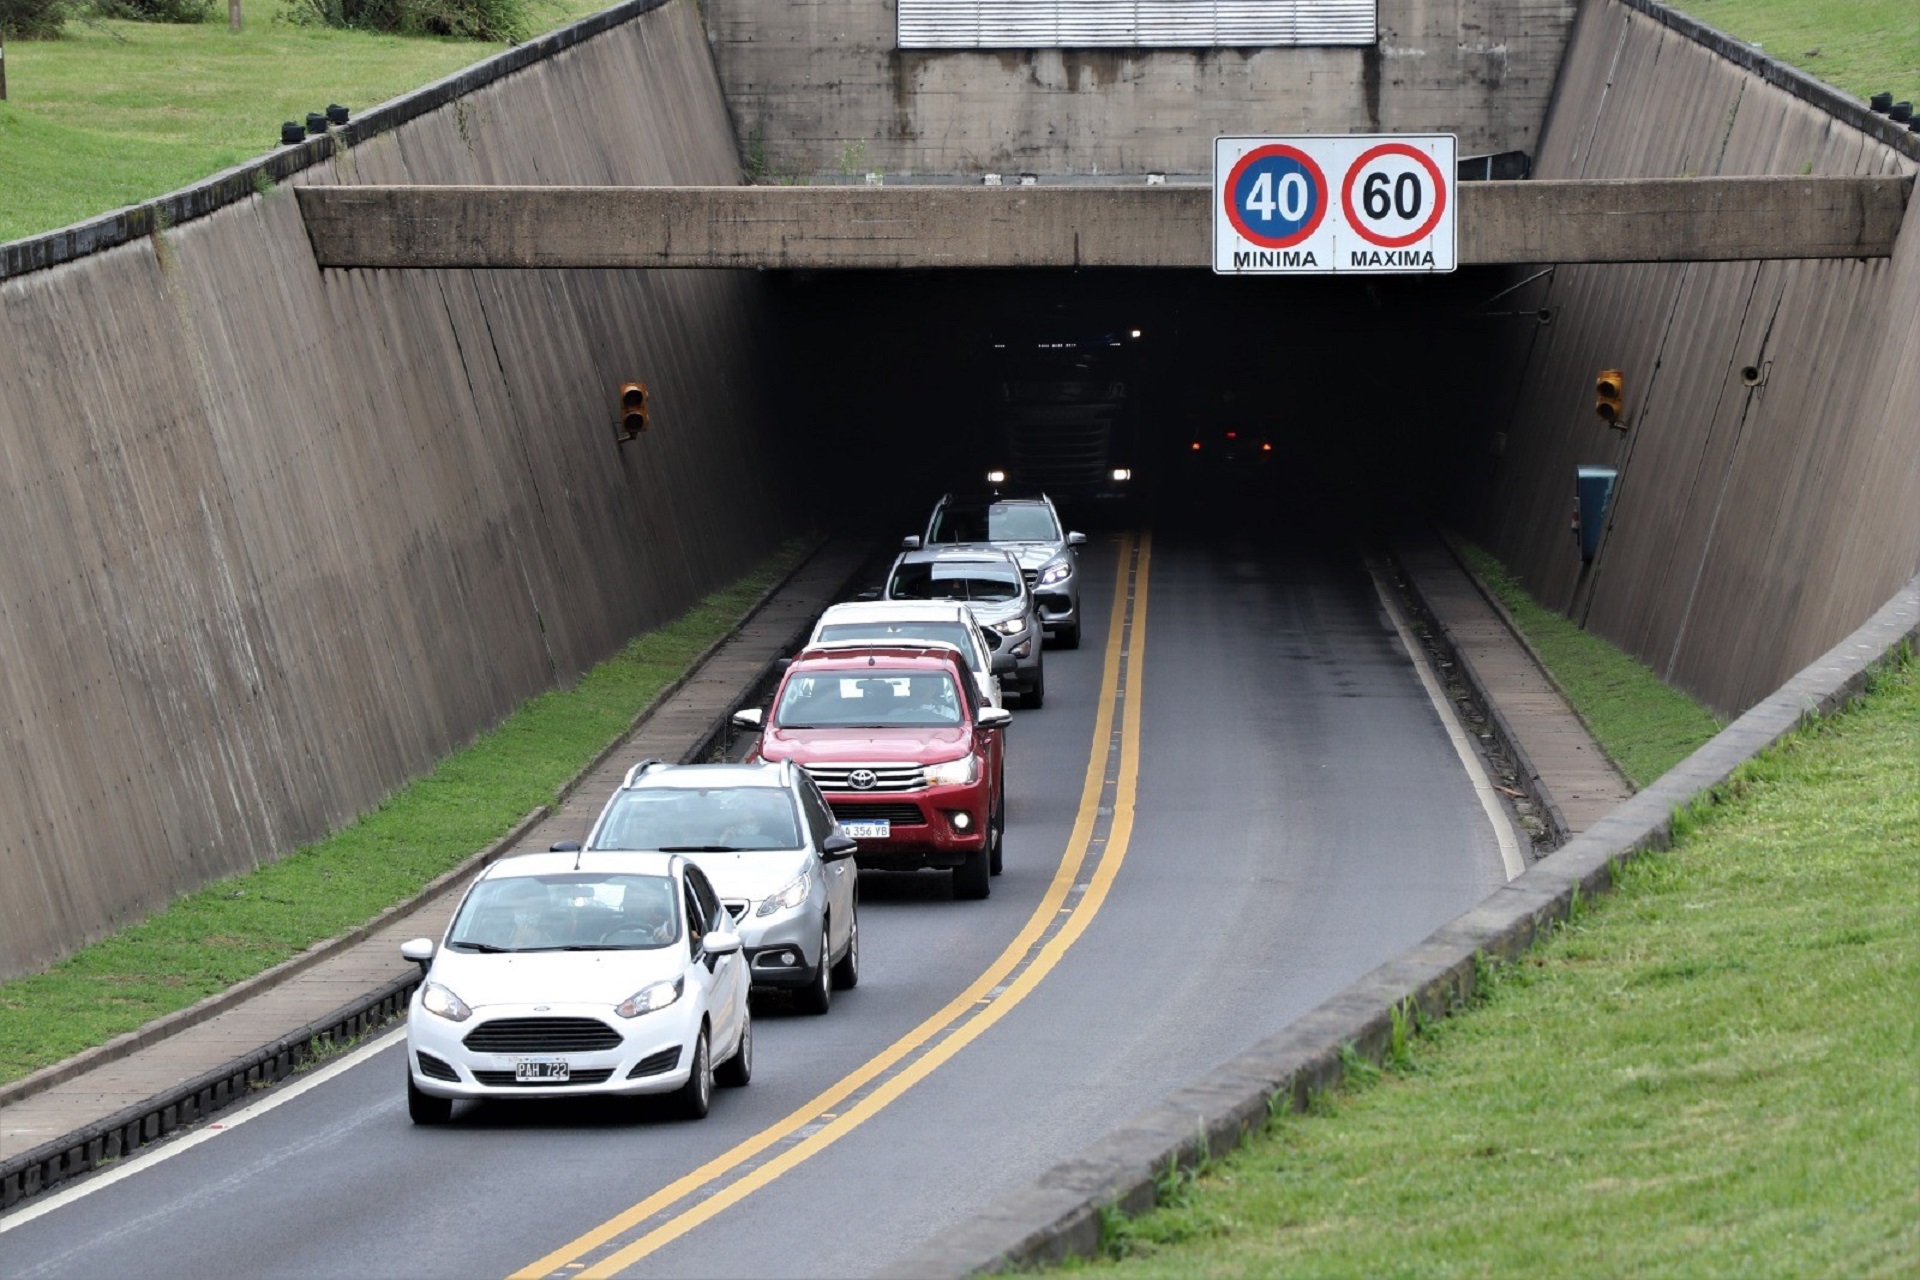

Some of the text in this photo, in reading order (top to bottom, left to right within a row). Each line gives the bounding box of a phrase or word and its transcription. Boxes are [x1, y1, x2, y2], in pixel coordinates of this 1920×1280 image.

[1246, 172, 1308, 221] 40
[1363, 171, 1422, 220] 60
[1234, 251, 1318, 267] MINIMA
[1351, 251, 1435, 266] MAXIMA
[853, 827, 872, 836] 356
[518, 1063, 567, 1077] PAH 722
